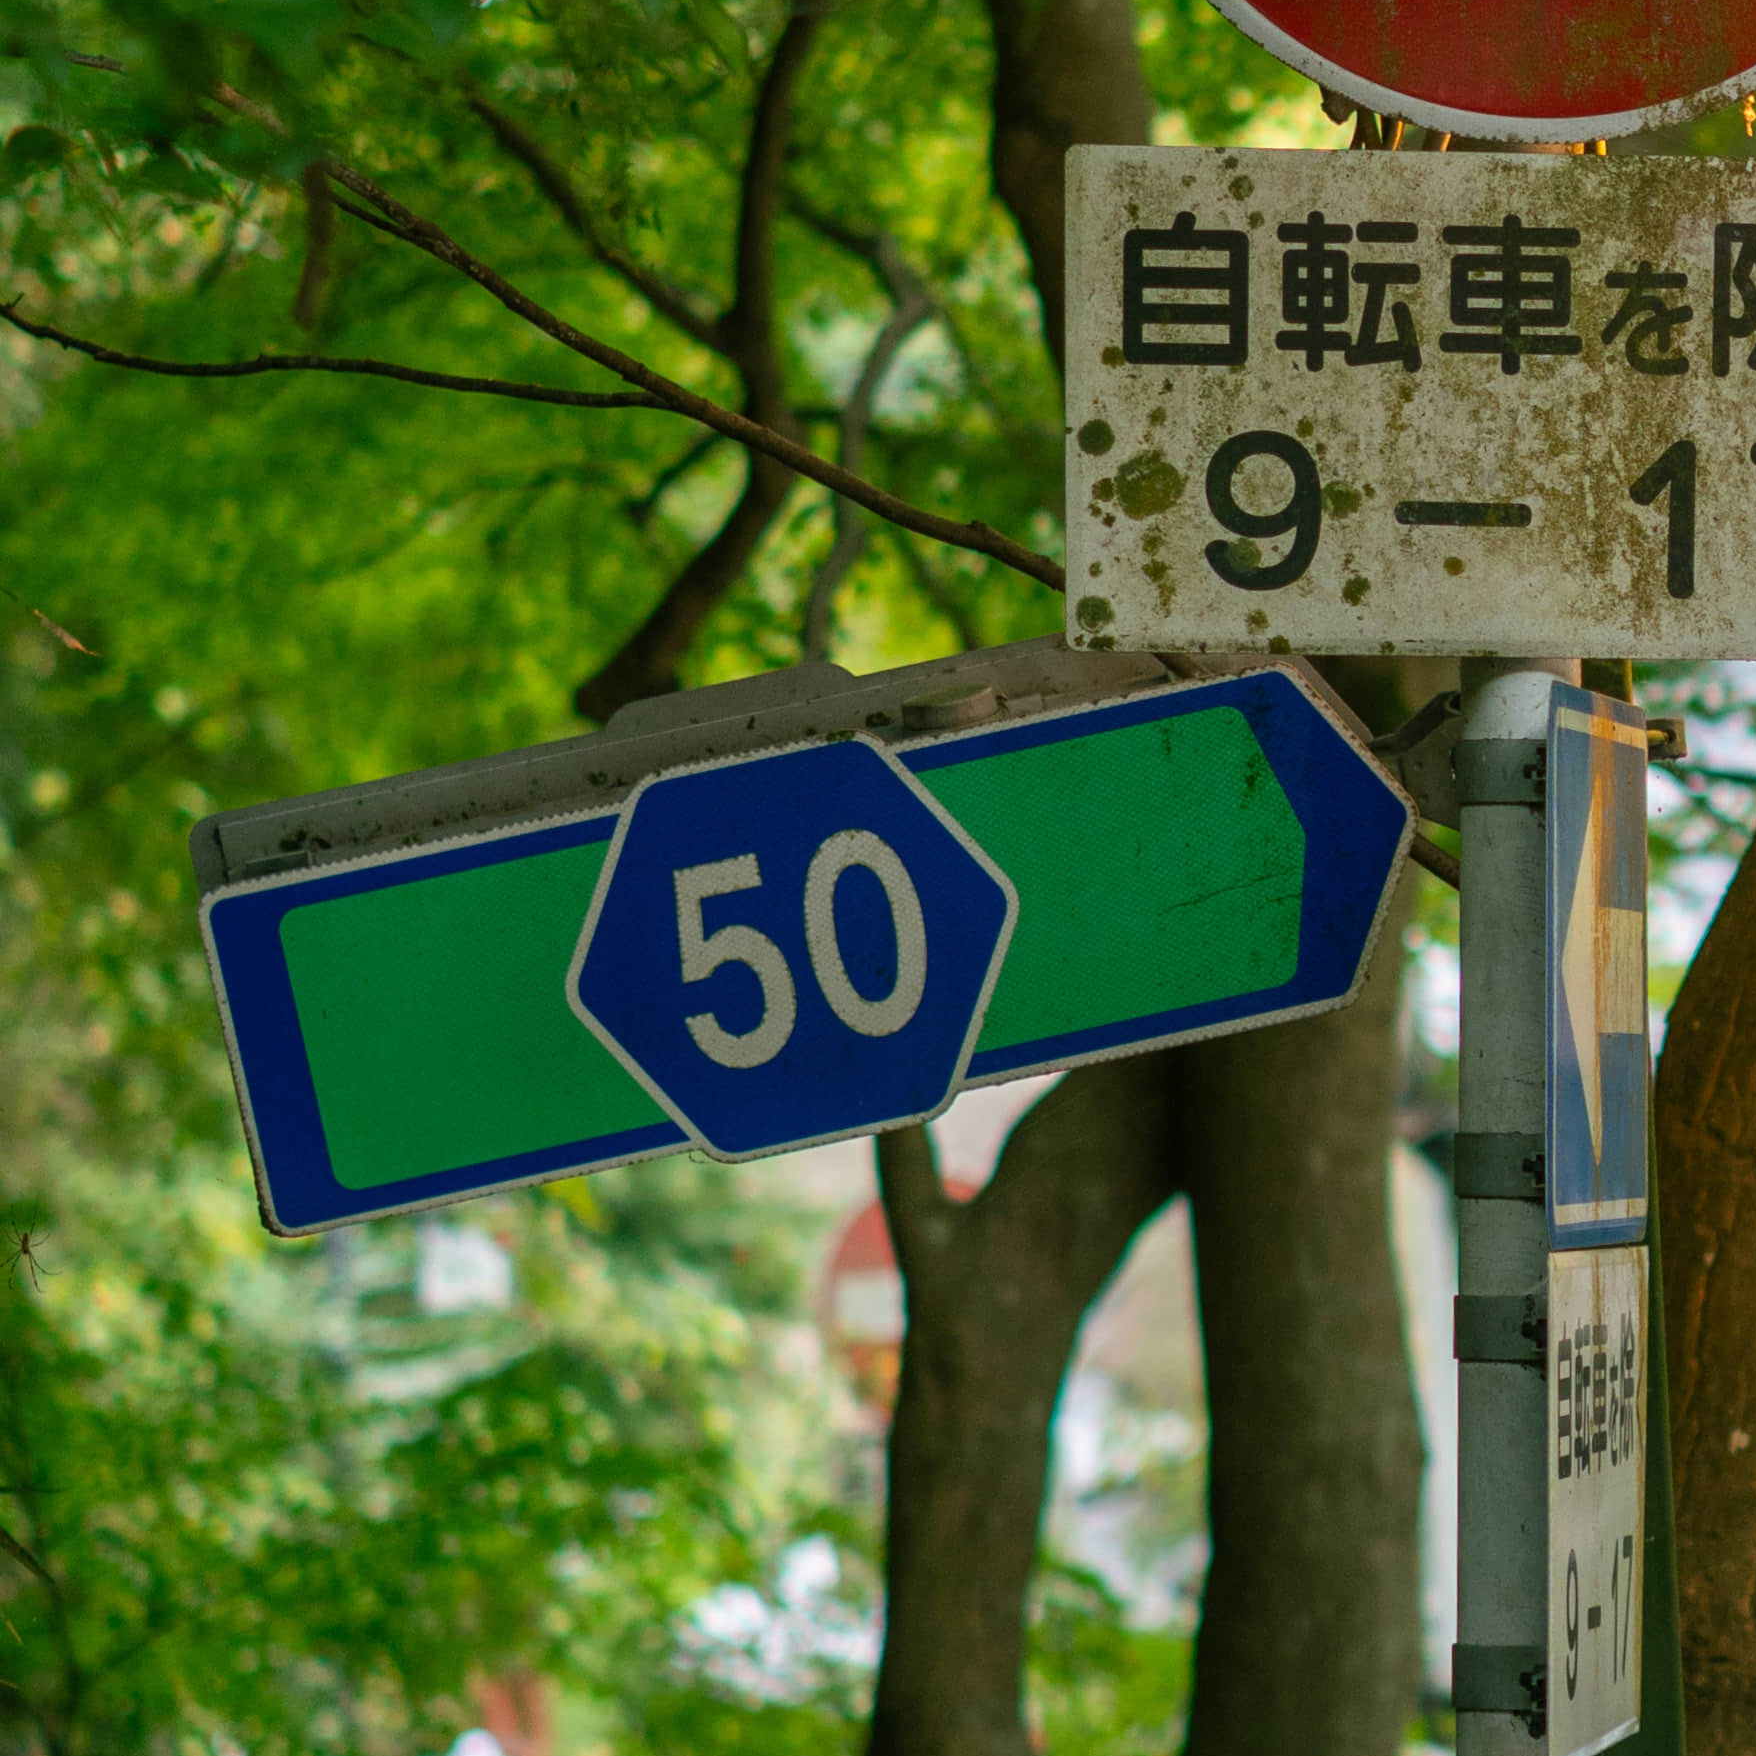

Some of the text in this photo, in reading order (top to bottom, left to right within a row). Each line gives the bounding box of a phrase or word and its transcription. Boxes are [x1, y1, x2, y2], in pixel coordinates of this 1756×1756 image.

[1204, 429, 1322, 592] 9
[672, 828, 928, 1070] 50
[1558, 1310, 1644, 1479] 自転車を除く
